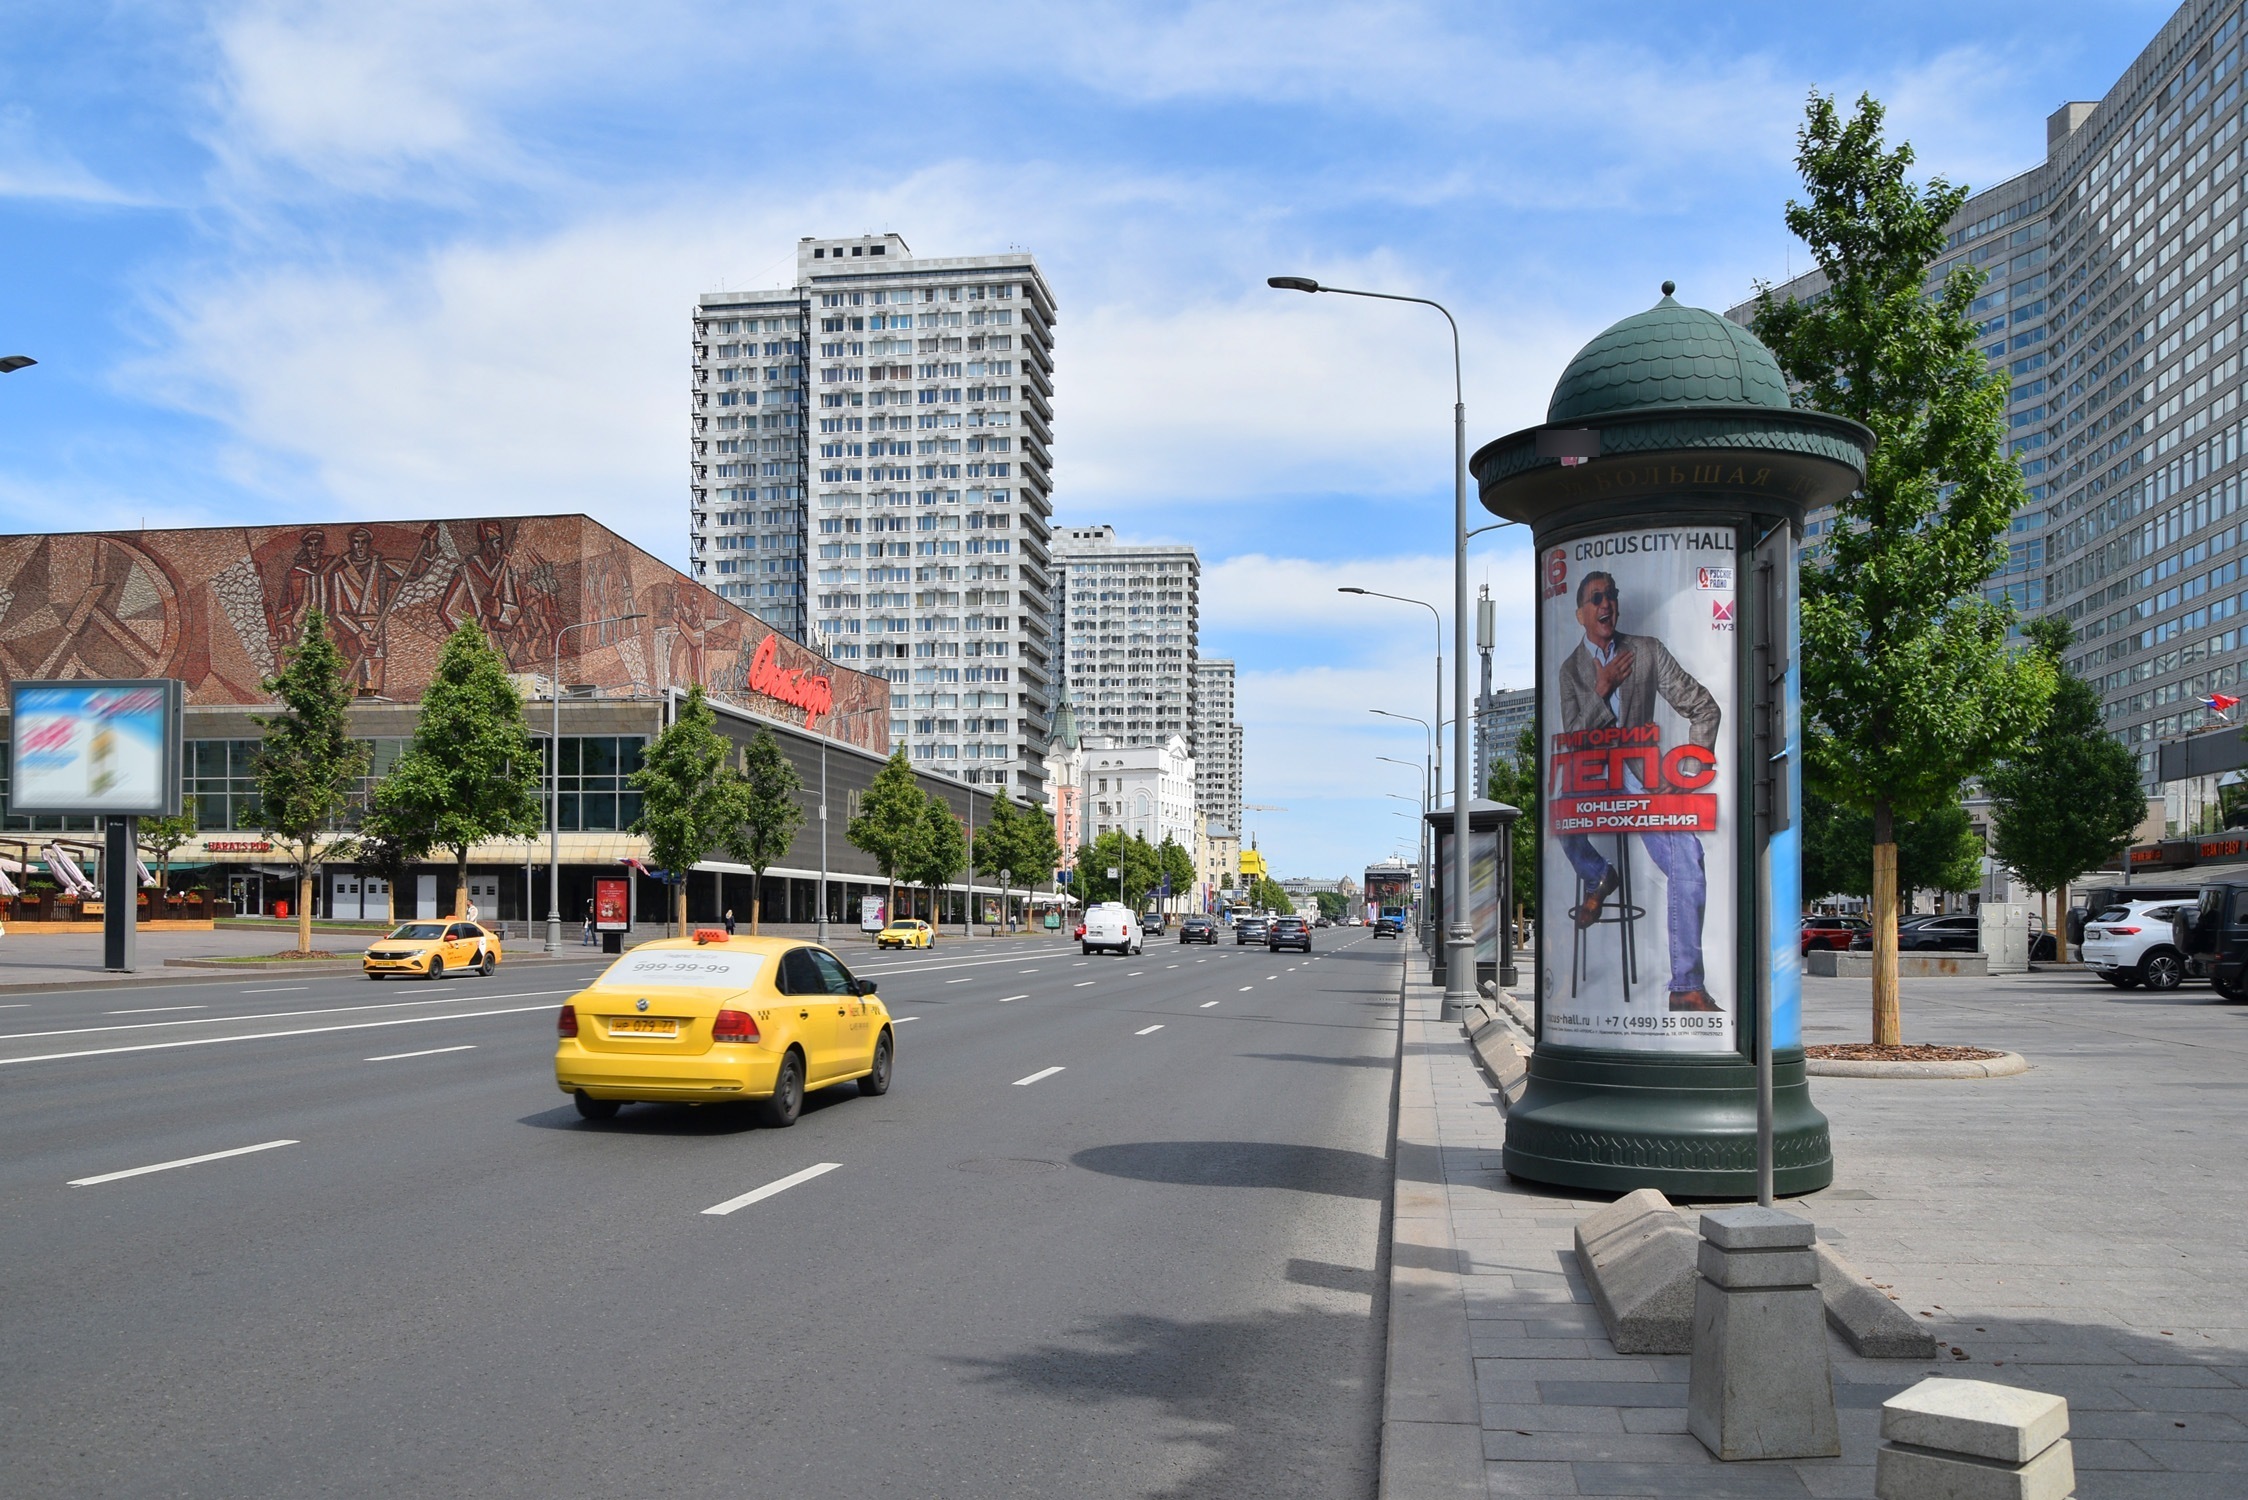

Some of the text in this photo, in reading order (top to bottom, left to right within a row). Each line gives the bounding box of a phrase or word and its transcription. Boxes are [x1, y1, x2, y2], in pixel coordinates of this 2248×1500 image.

[1596, 465, 1772, 491] БОЛЬШАЯ
[1575, 532, 1734, 562] CROCUS CITY HALL
[1551, 723, 1660, 750] ГРИГОРИЙ
[1548, 743, 1717, 795] ЛЕПС
[1576, 799, 1651, 813] КОНЦЕРТ
[1562, 817, 1594, 830] ДЕНЬ
[1596, 814, 1698, 828] РОЖДЕНИЯ
[250, 842, 270, 852] PUB
[633, 963, 730, 974] 999-99-99
[1605, 1016, 1619, 1027] +7
[1623, 1016, 1658, 1029] (499)
[1662, 1017, 1676, 1028] 55
[1680, 1017, 1704, 1028] 000
[1708, 1017, 1723, 1028] 55
